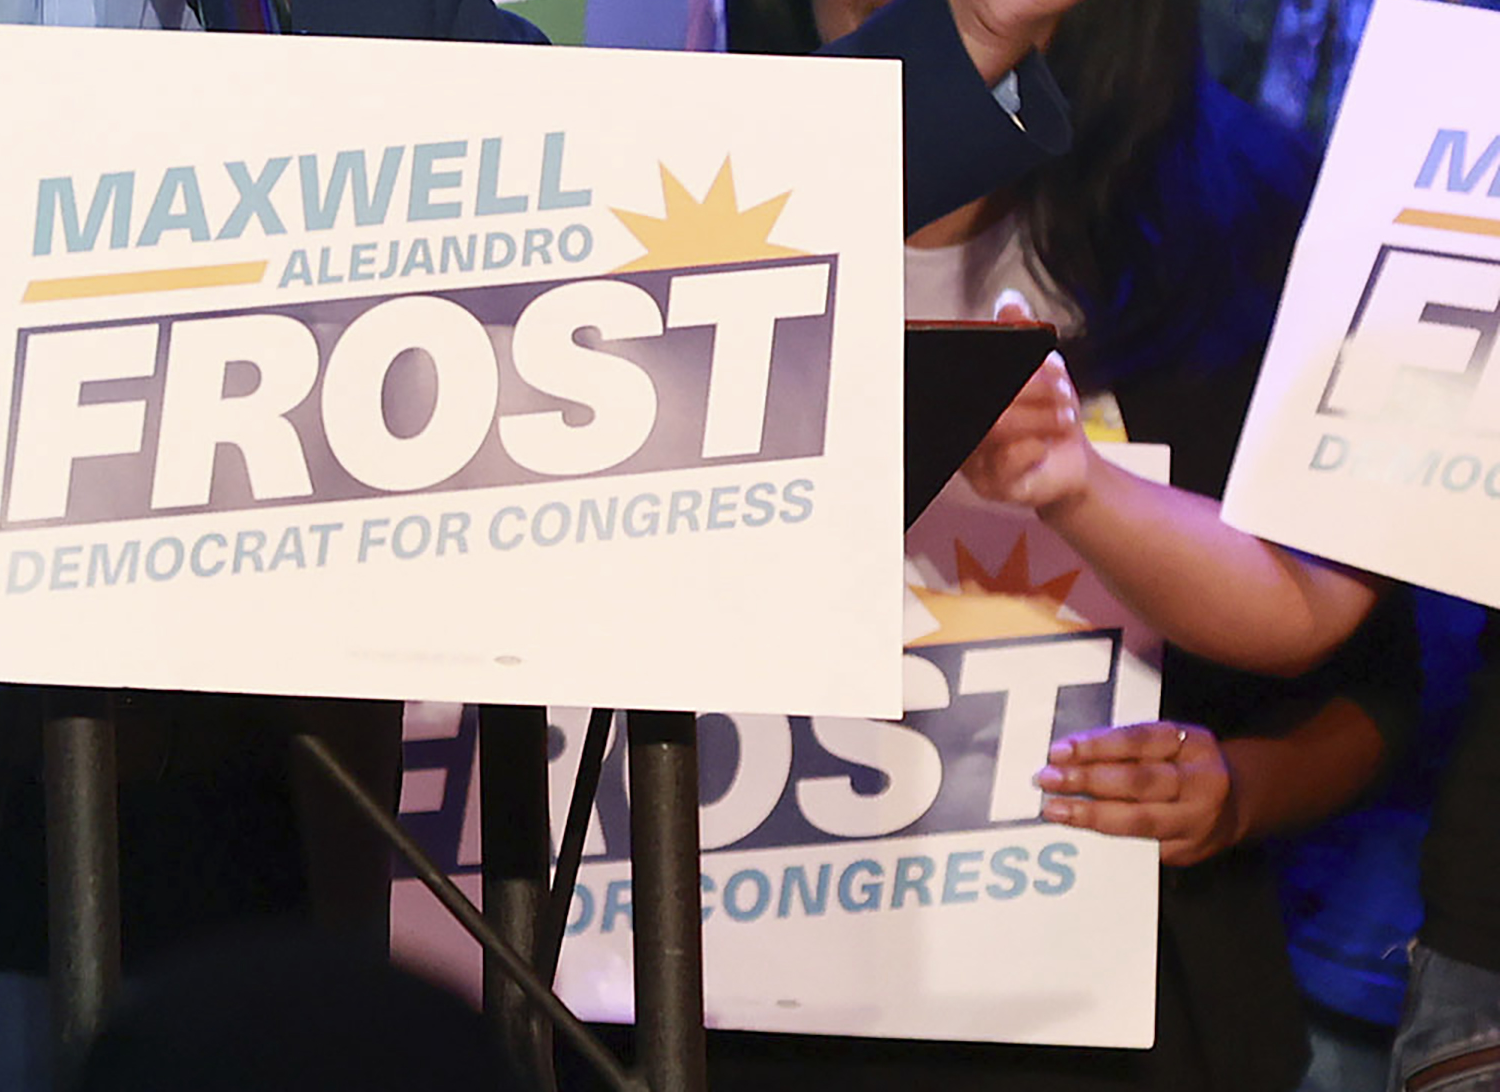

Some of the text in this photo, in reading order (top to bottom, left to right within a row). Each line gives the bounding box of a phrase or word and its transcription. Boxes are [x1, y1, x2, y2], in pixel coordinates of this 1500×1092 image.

[31, 131, 594, 257] MAXWELL
[278, 223, 595, 289] ALEJANDRO
[7, 263, 832, 523] FROST
[4, 478, 816, 596] DEMOCRAT FOR CONGRESS
